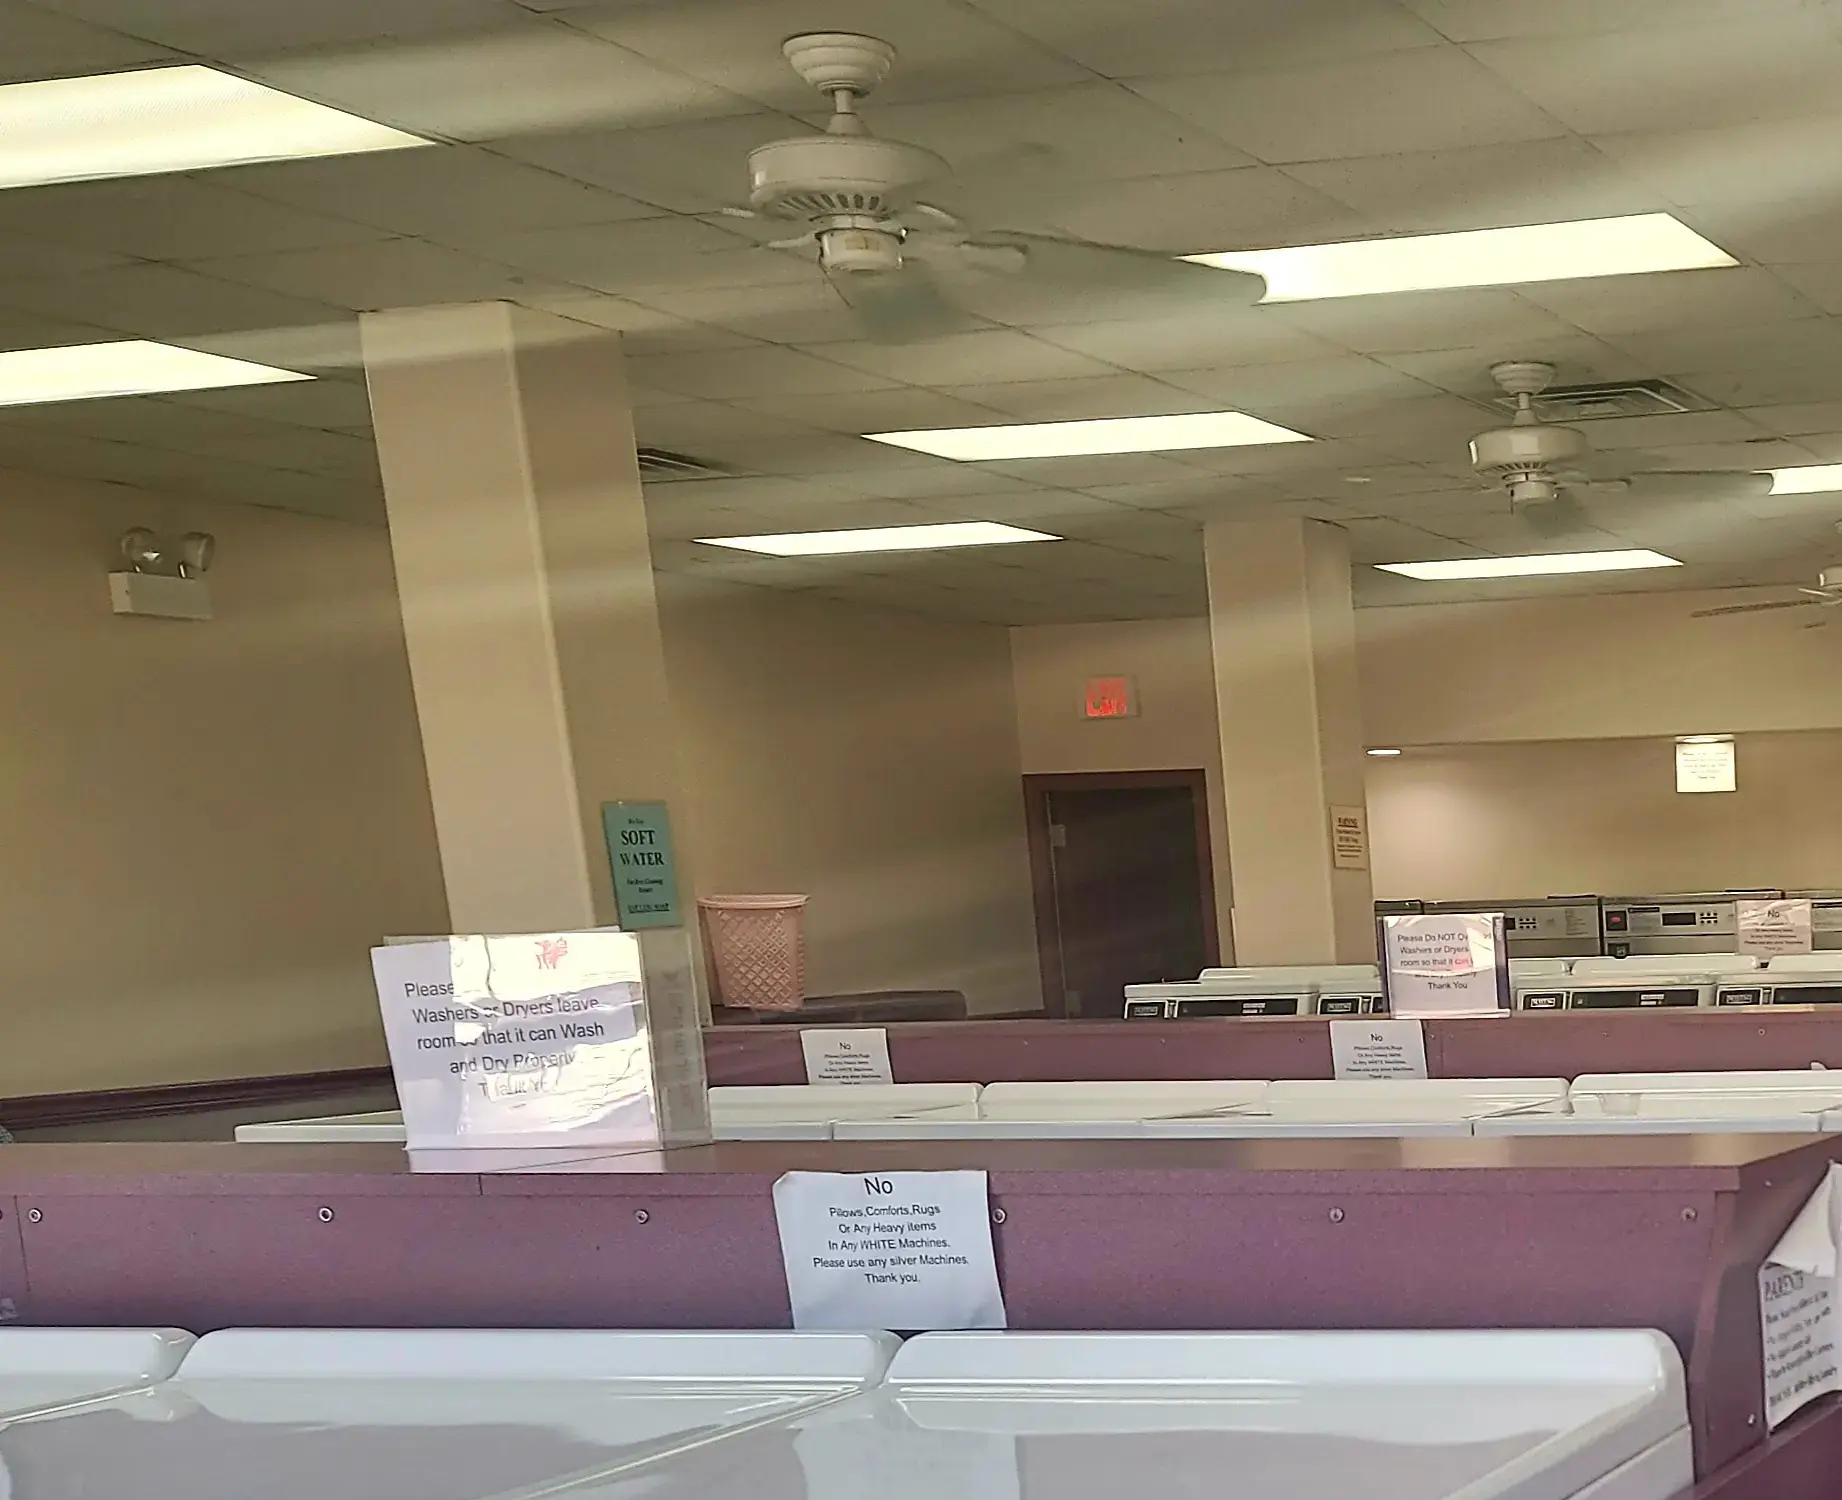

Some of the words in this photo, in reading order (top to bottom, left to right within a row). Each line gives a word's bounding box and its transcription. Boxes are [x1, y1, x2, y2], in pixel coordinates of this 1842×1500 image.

[621, 830, 655, 845] SOFT
[620, 852, 665, 866] WATER
[1767, 909, 1780, 918] No
[1438, 933, 1455, 941] NOT
[405, 981, 454, 998] Please
[1453, 981, 1468, 989] You
[412, 1003, 479, 1024] Washers
[503, 1000, 553, 1022] Dryers
[558, 997, 599, 1013] leave
[417, 1032, 455, 1049] room
[482, 1027, 513, 1045] that
[515, 1026, 526, 1043] it
[529, 1027, 557, 1042] can
[559, 1022, 604, 1039] Wash
[1370, 1033, 1383, 1042] No
[839, 1042, 851, 1050] No
[450, 1057, 477, 1074] and
[482, 1055, 508, 1075] Dry
[864, 1177, 893, 1195] No
[838, 1223, 851, 1234] Or
[853, 1223, 871, 1236] Any
[873, 1222, 905, 1235] Heavy
[828, 1240, 838, 1250] In
[840, 1239, 858, 1252] Any
[860, 1239, 896, 1250] WHITE
[813, 1257, 845, 1268] Please
[847, 1259, 865, 1268] use
[868, 1258, 887, 1270] any
[890, 1255, 917, 1266] silver
[864, 1273, 897, 1284] Thank
